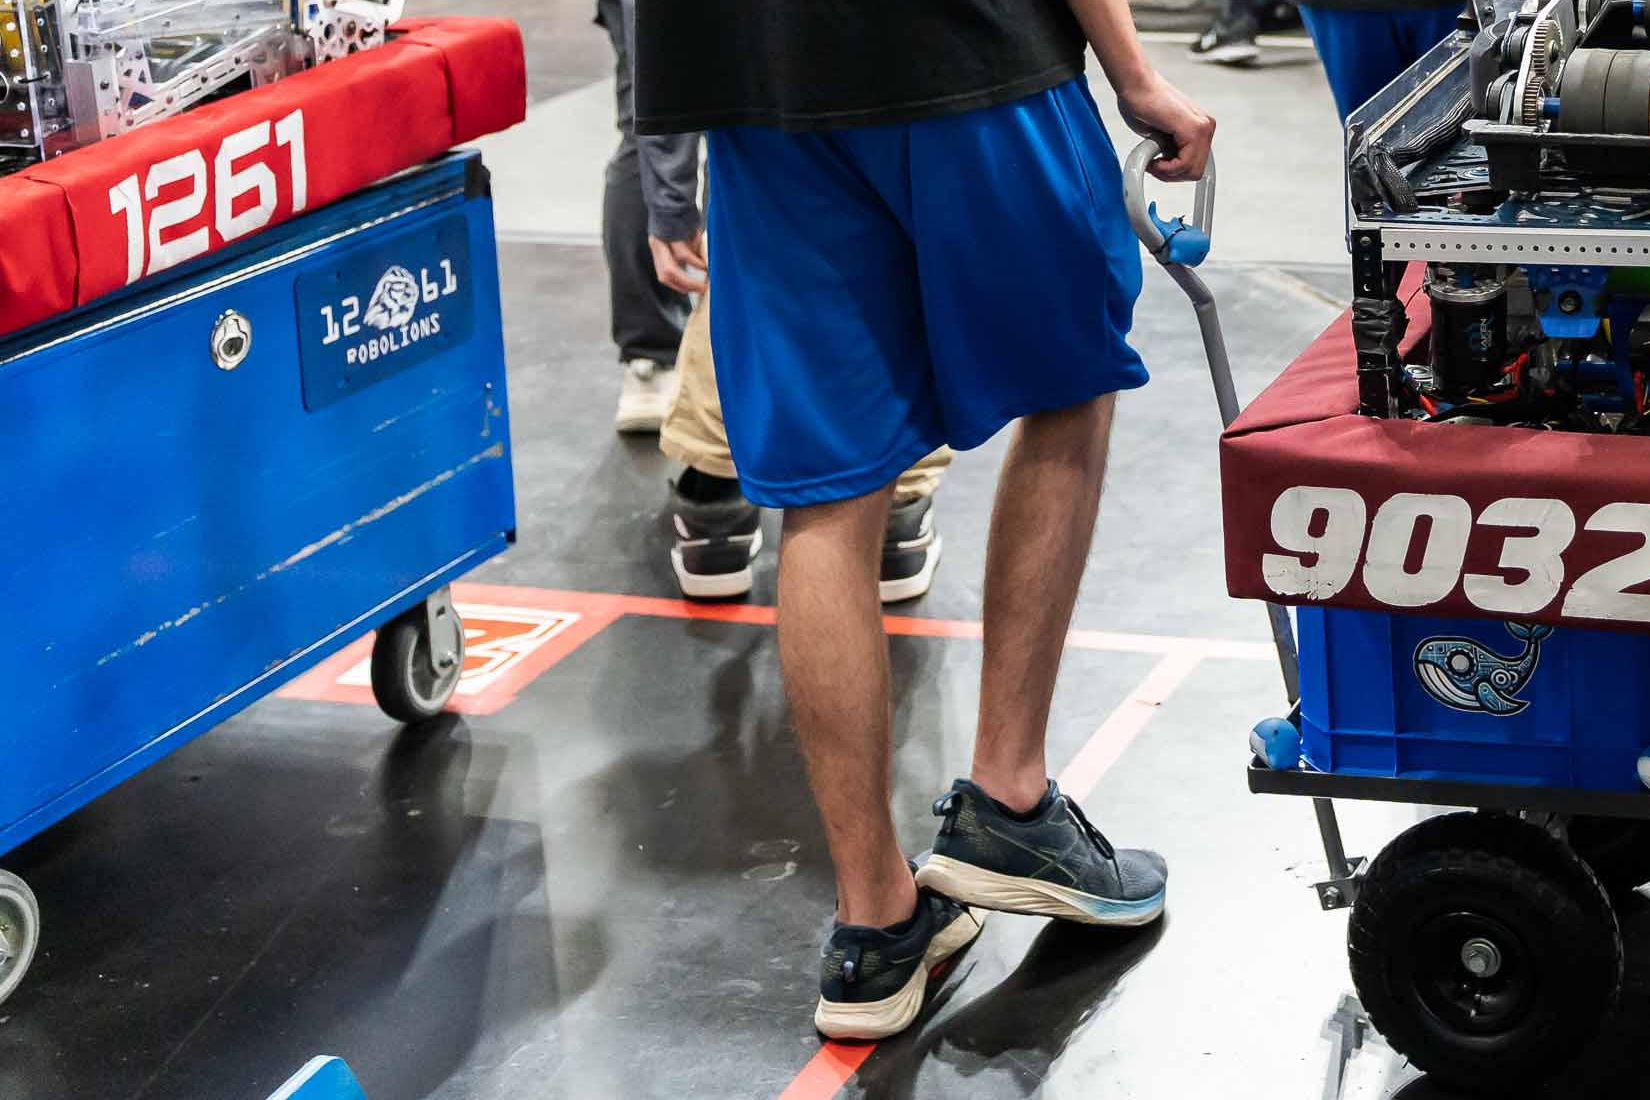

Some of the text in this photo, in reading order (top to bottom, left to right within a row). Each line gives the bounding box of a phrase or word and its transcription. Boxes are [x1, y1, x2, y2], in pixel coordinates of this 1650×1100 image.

[108, 108, 309, 285] 1261
[321, 258, 458, 345] 12 61
[345, 312, 441, 365] ROBOLIONS
